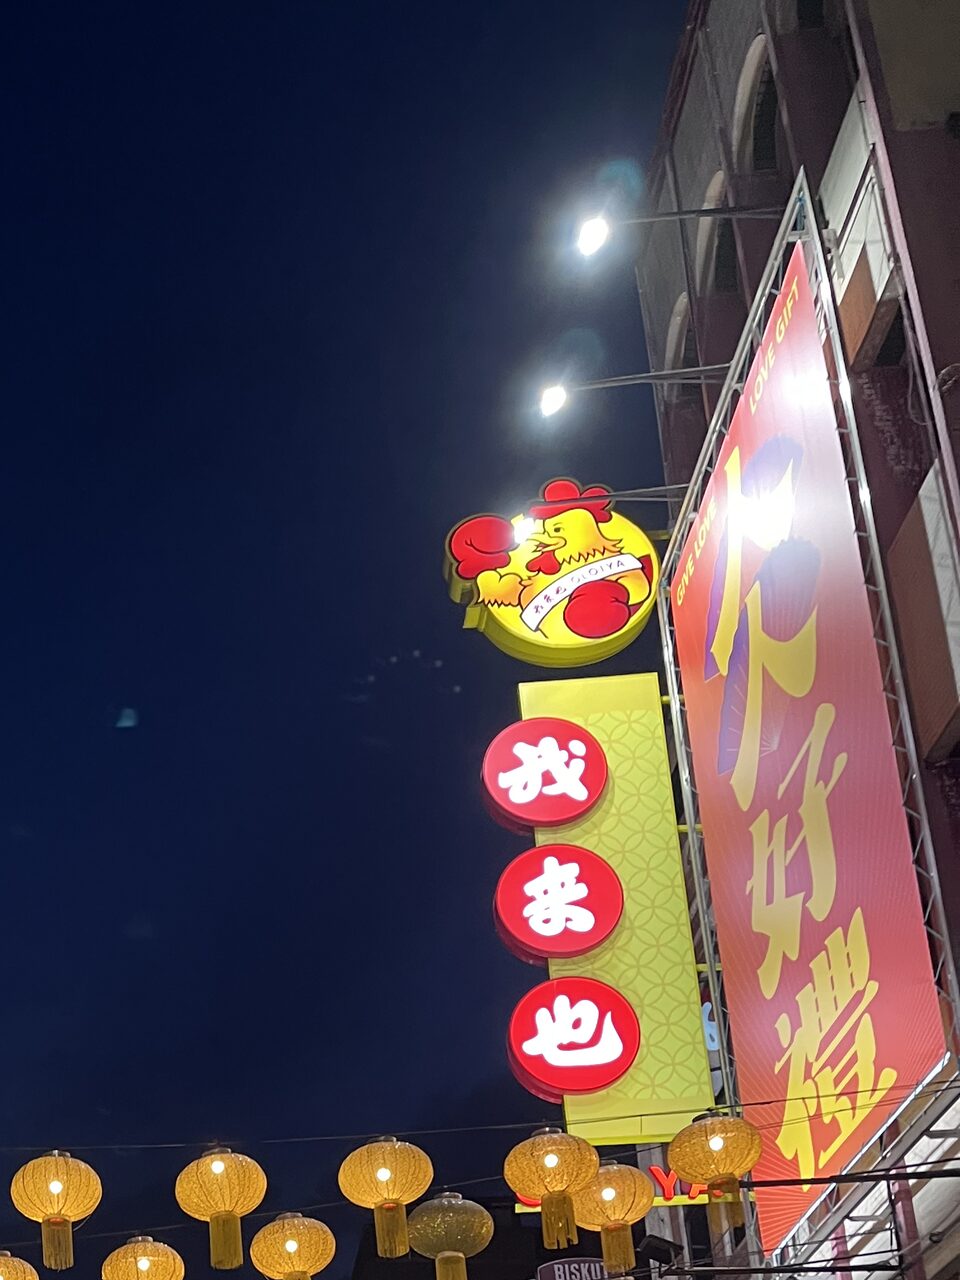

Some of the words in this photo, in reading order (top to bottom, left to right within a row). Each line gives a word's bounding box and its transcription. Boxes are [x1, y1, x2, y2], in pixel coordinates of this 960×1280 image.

[749, 342, 776, 416] LOVE
[775, 276, 799, 344] GIFT
[571, 559, 625, 584] OLOIYA
[676, 553, 695, 606] GIVE
[693, 496, 717, 559] LOVE
